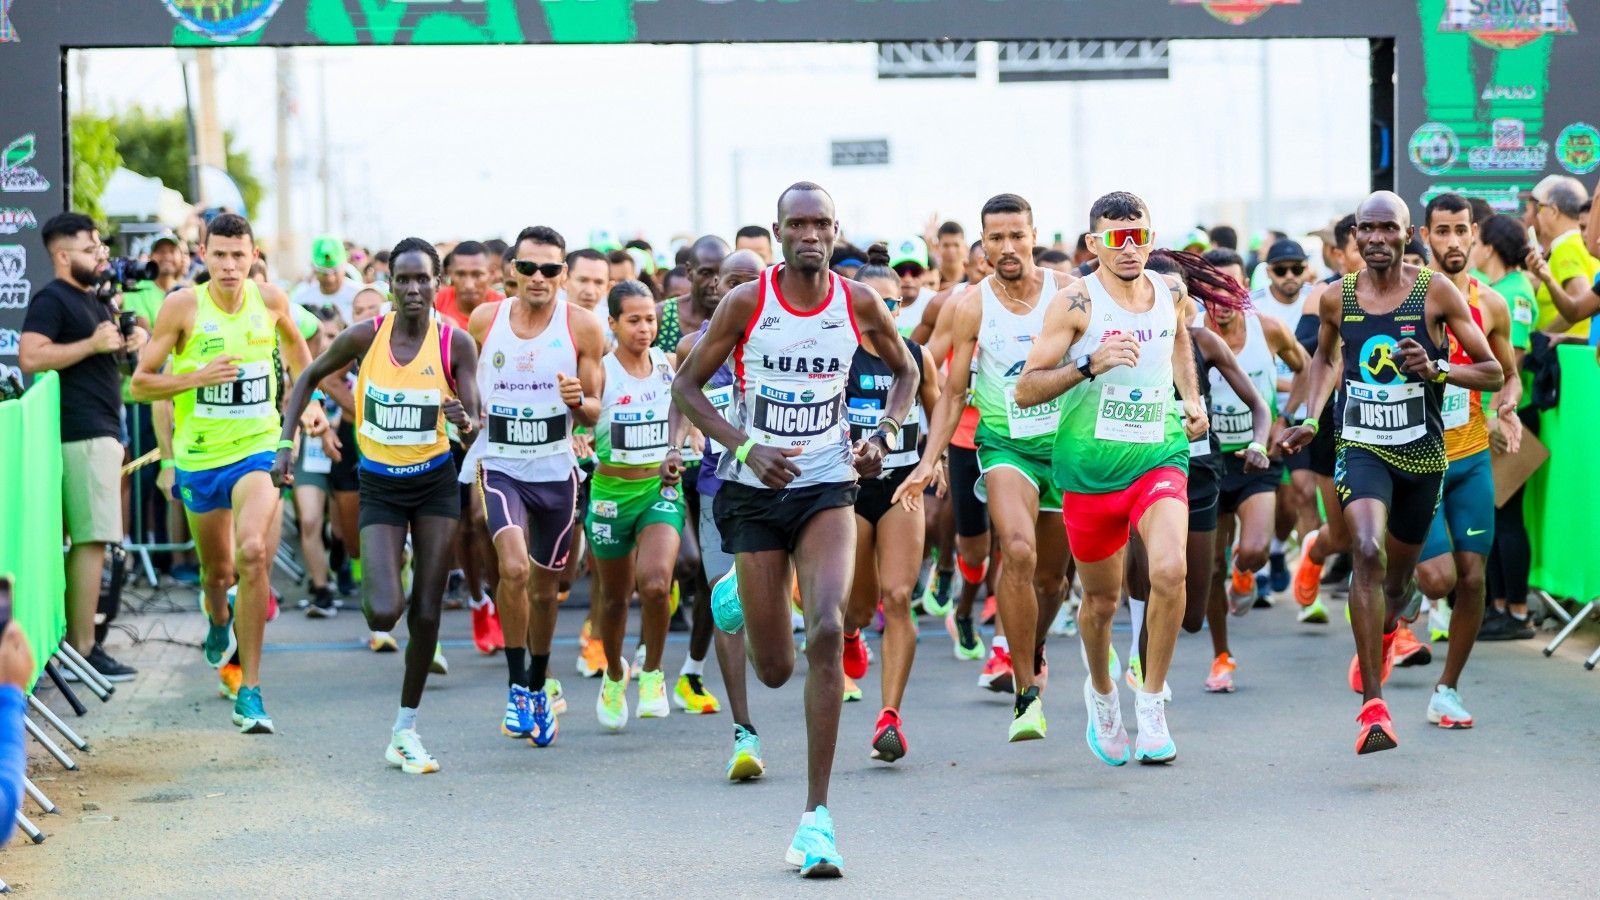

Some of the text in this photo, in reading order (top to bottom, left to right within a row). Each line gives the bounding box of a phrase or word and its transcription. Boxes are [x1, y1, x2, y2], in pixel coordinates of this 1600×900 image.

[763, 354, 840, 373] LUASA
[241, 377, 267, 403] SON
[494, 381, 554, 392] polpanorte
[766, 389, 789, 400] ELITE
[1354, 389, 1370, 398] ELITE
[375, 402, 422, 429] VIVIAN
[765, 402, 834, 433] NICOLAS
[852, 414, 872, 423] ELITE
[1103, 401, 1154, 421] 50321
[1359, 402, 1408, 428] JUSTIN
[394, 461, 431, 475] SPORTS
